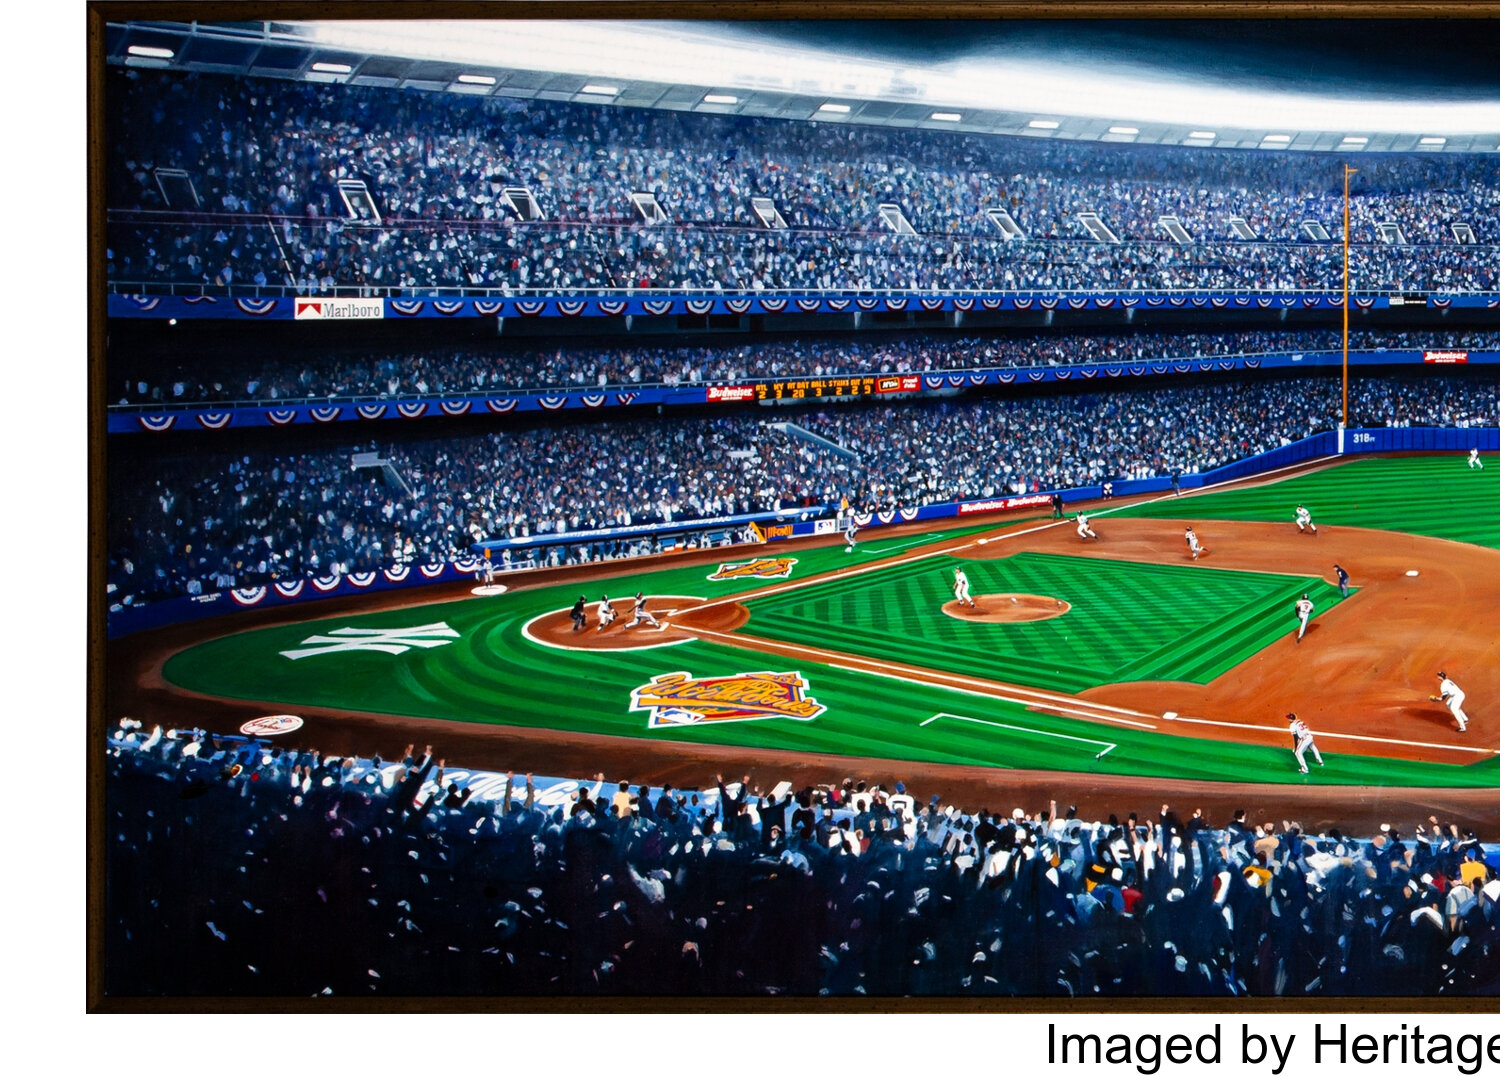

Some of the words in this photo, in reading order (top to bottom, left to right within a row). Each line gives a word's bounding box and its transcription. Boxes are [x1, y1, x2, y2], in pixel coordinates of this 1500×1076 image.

[323, 303, 380, 318] Marlboro
[1424, 351, 1468, 360] Budweiser
[774, 382, 784, 391] NY
[787, 382, 796, 390] AT
[811, 380, 826, 388] BALL
[828, 379, 849, 387] STRIKE
[850, 378, 861, 387] OUT
[709, 387, 753, 398] Budweiser
[759, 391, 767, 399] 2
[776, 390, 783, 399] 3
[792, 389, 805, 398] 20
[815, 387, 822, 396] 3
[836, 387, 842, 396] 2
[851, 386, 859, 395] 2
[864, 385, 871, 394] 9
[1353, 434, 1369, 444] 318
